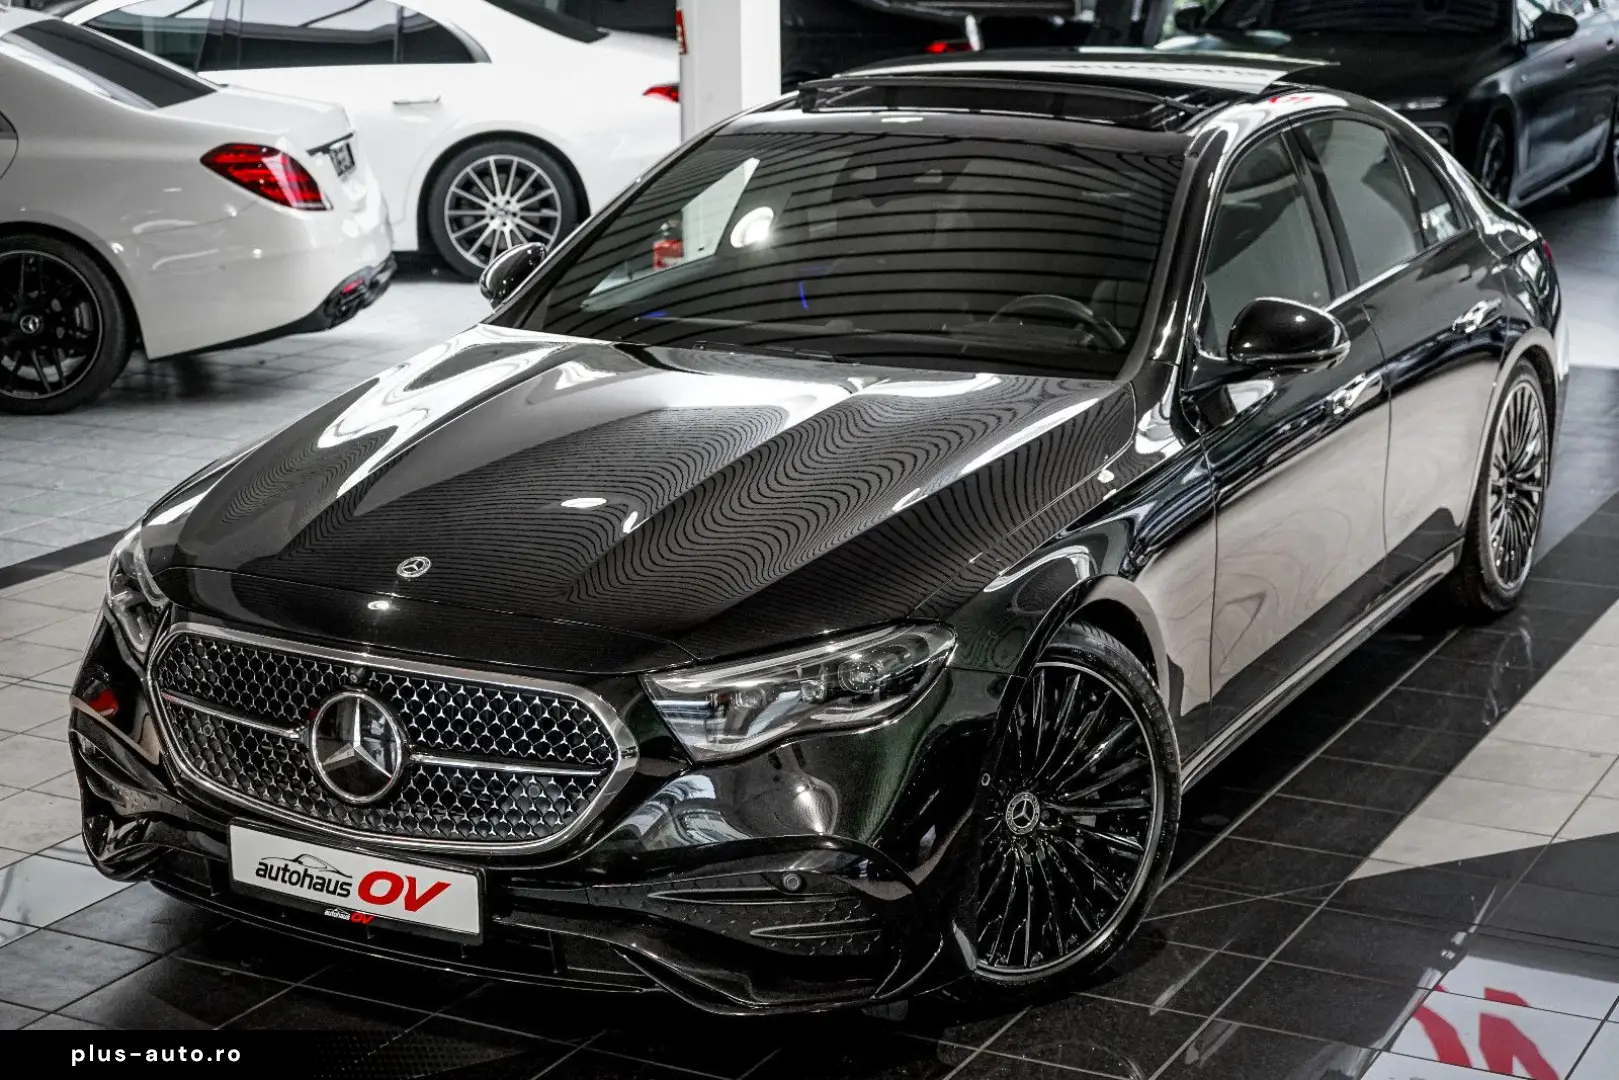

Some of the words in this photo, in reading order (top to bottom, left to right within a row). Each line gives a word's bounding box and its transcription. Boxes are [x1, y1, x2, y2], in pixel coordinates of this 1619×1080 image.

[255, 861, 352, 898] autohaus
[357, 870, 452, 913] OV
[324, 910, 351, 921] autohaus
[351, 911, 374, 925] OV
